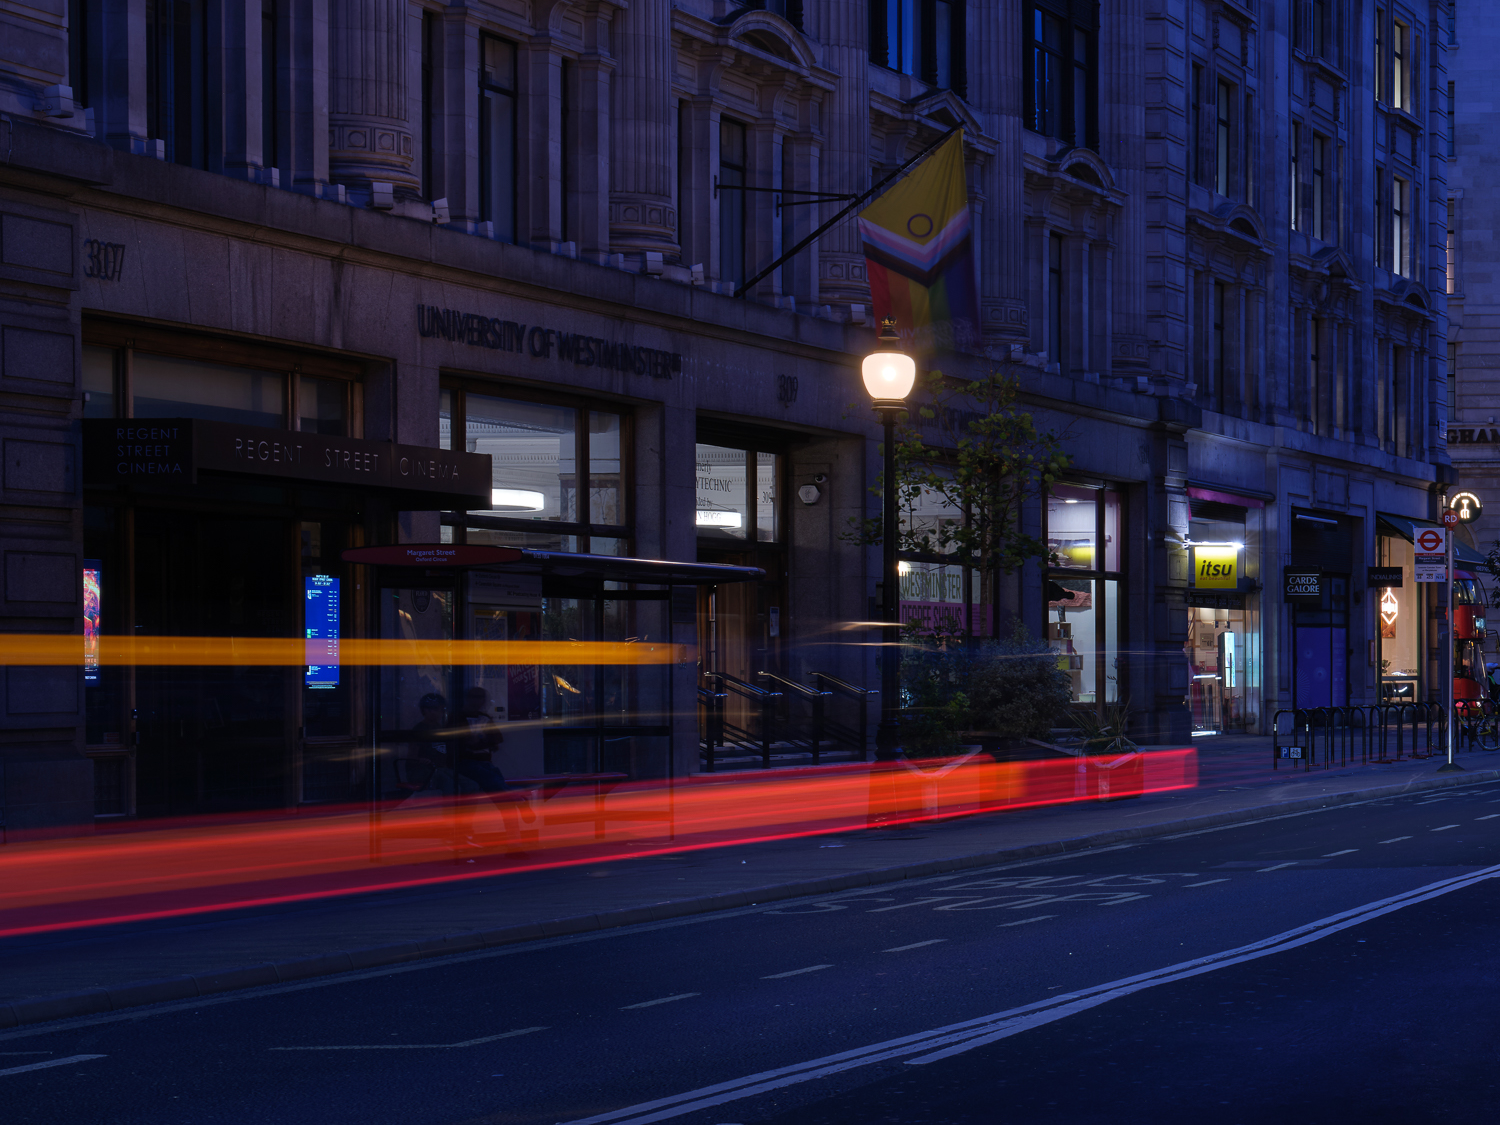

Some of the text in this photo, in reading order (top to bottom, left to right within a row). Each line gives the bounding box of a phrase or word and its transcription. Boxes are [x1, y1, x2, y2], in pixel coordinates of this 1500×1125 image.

[417, 304, 673, 380] UNIVERSITY OF WESTMINSTER
[117, 428, 179, 440] REGENT
[117, 445, 170, 457] STREET
[235, 438, 460, 480] REGENT STREET CINEMA
[117, 462, 182, 475] CINEMA
[1444, 515, 1458, 523] RD
[1200, 560, 1232, 577] itsu
[902, 571, 961, 600] WESTMINSTER
[1289, 576, 1317, 584] CARDS
[1287, 585, 1320, 593] GALORE
[1282, 748, 1288, 757] P
[931, 873, 1199, 891] BUS
[763, 893, 1152, 915] STOP
